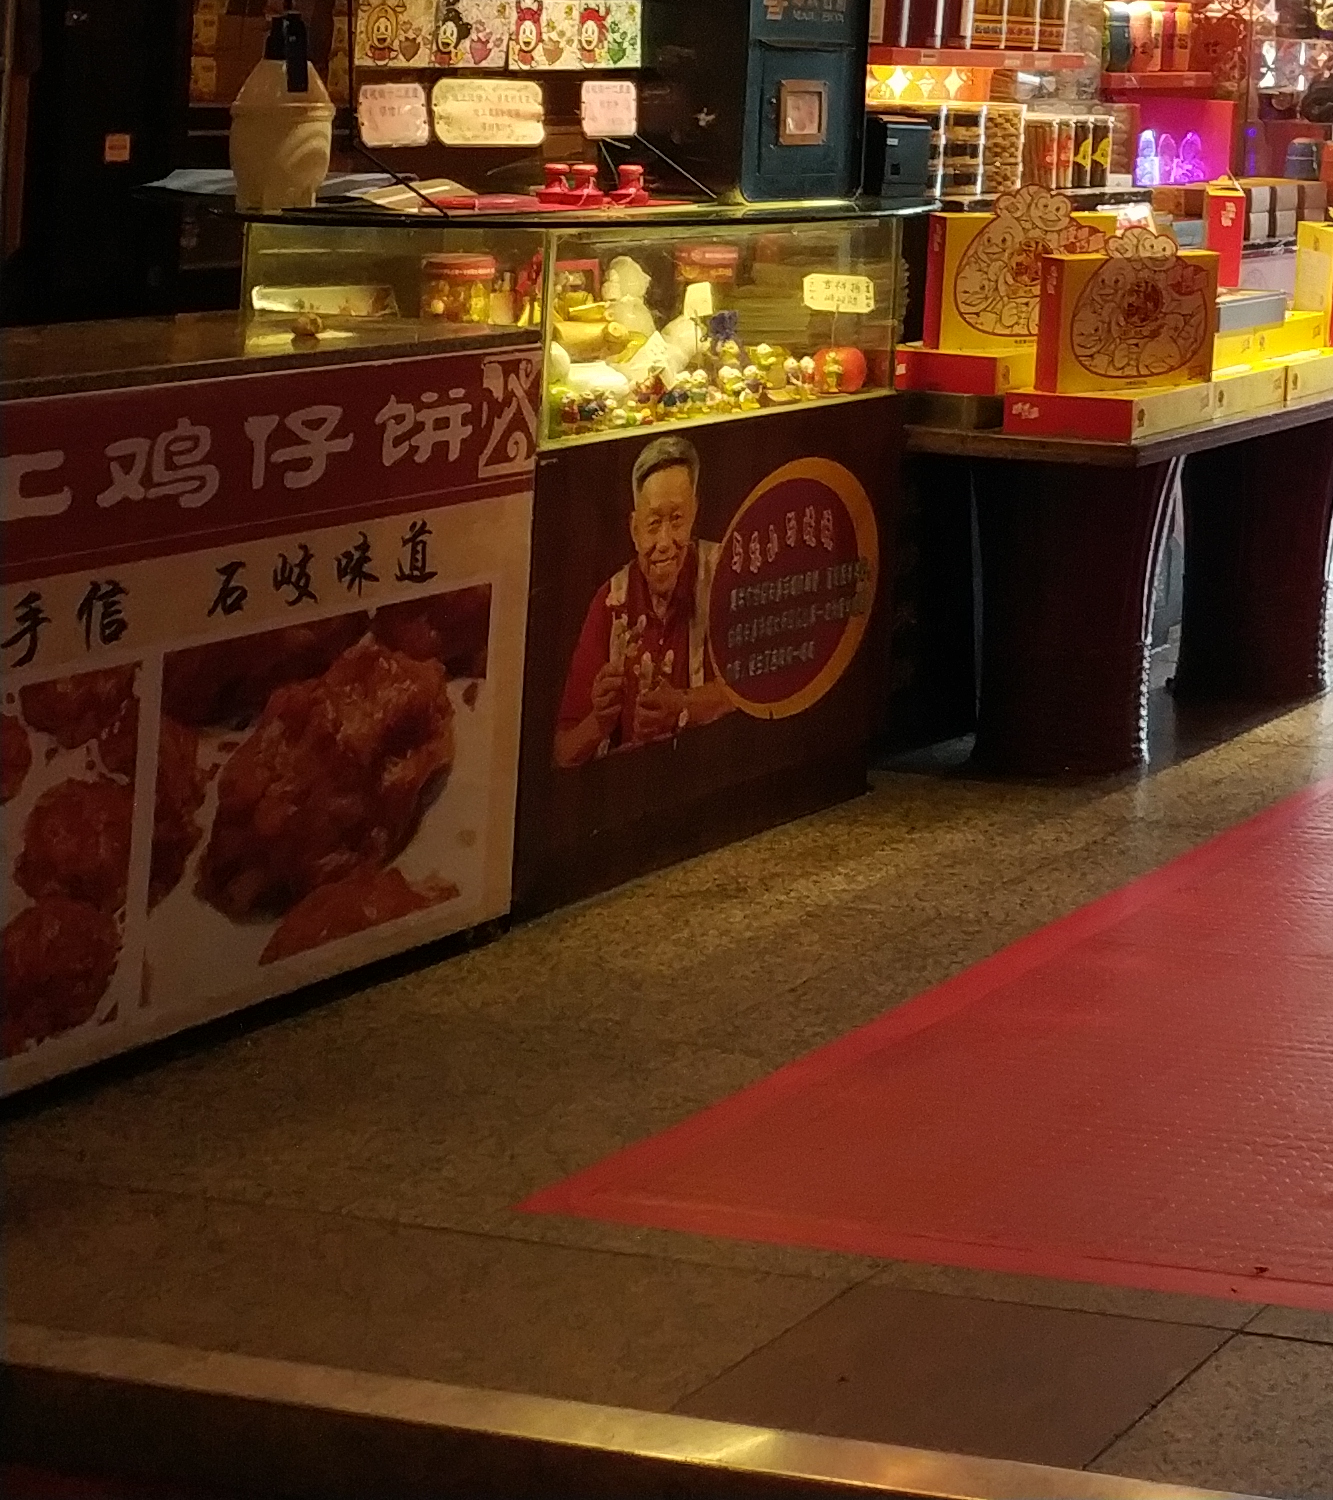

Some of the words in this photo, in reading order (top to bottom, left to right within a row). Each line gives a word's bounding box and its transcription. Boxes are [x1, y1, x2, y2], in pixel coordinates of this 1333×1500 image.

[0, 579, 132, 669] 手信
[205, 521, 440, 620] 石岐味道
